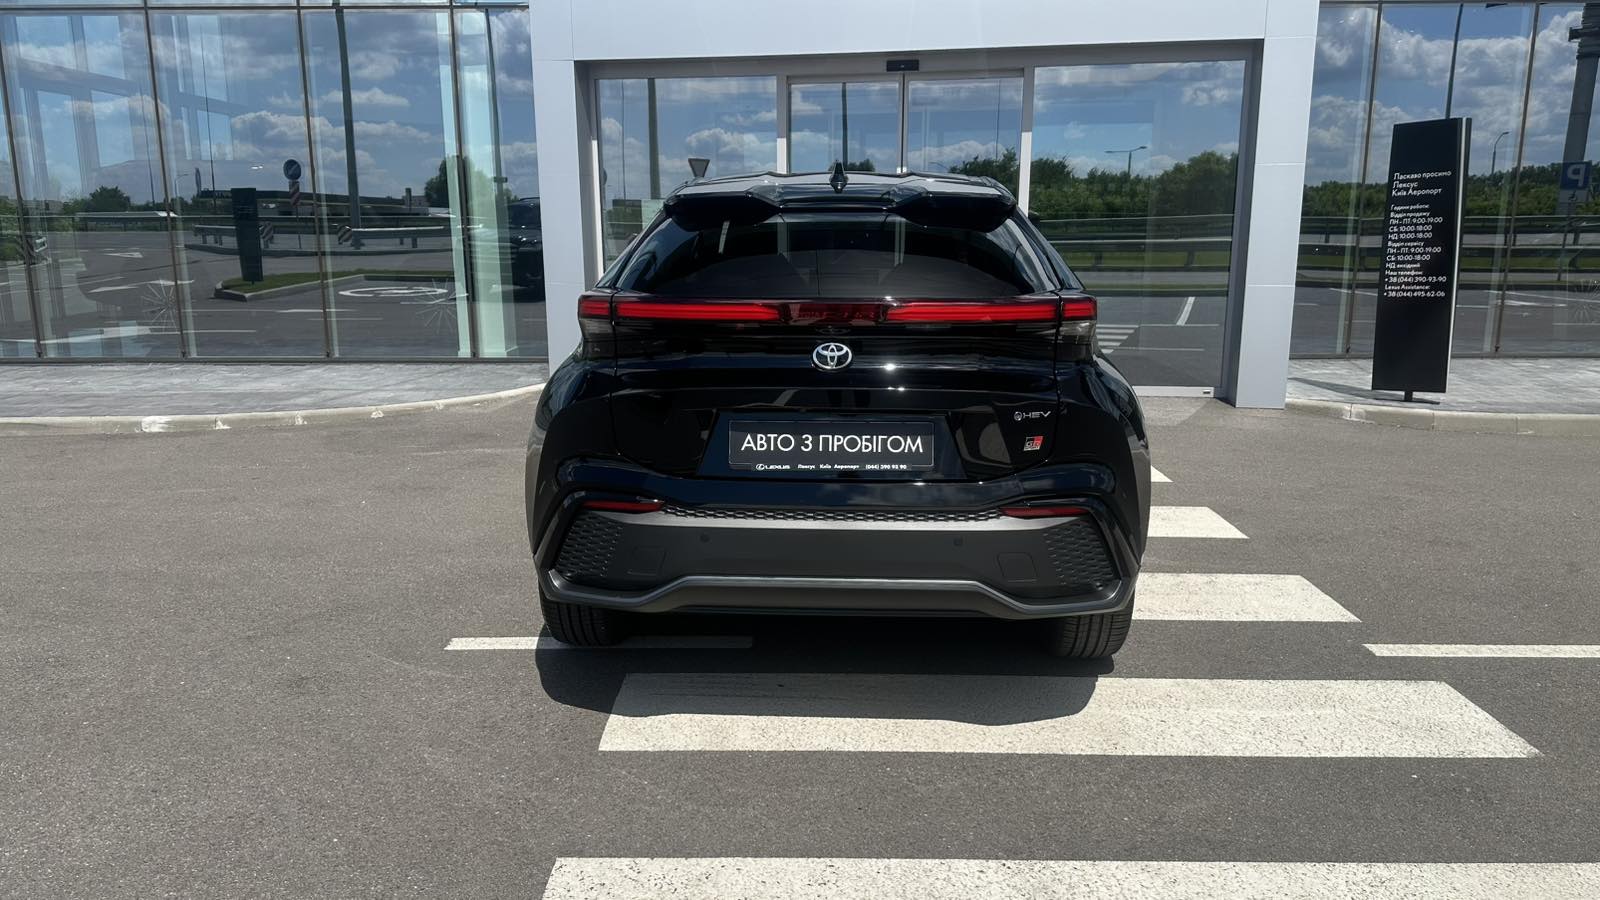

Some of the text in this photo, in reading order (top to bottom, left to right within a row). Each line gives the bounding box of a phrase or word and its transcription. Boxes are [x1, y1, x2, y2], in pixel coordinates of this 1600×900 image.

[1394, 172, 1421, 180] Ласкаво
[1393, 181, 1418, 189] Лексус
[1407, 188, 1442, 196] Аеропорт
[1023, 411, 1051, 419] HEV
[741, 433, 795, 452] АВТО
[819, 434, 923, 453] ПРОБІГОМ
